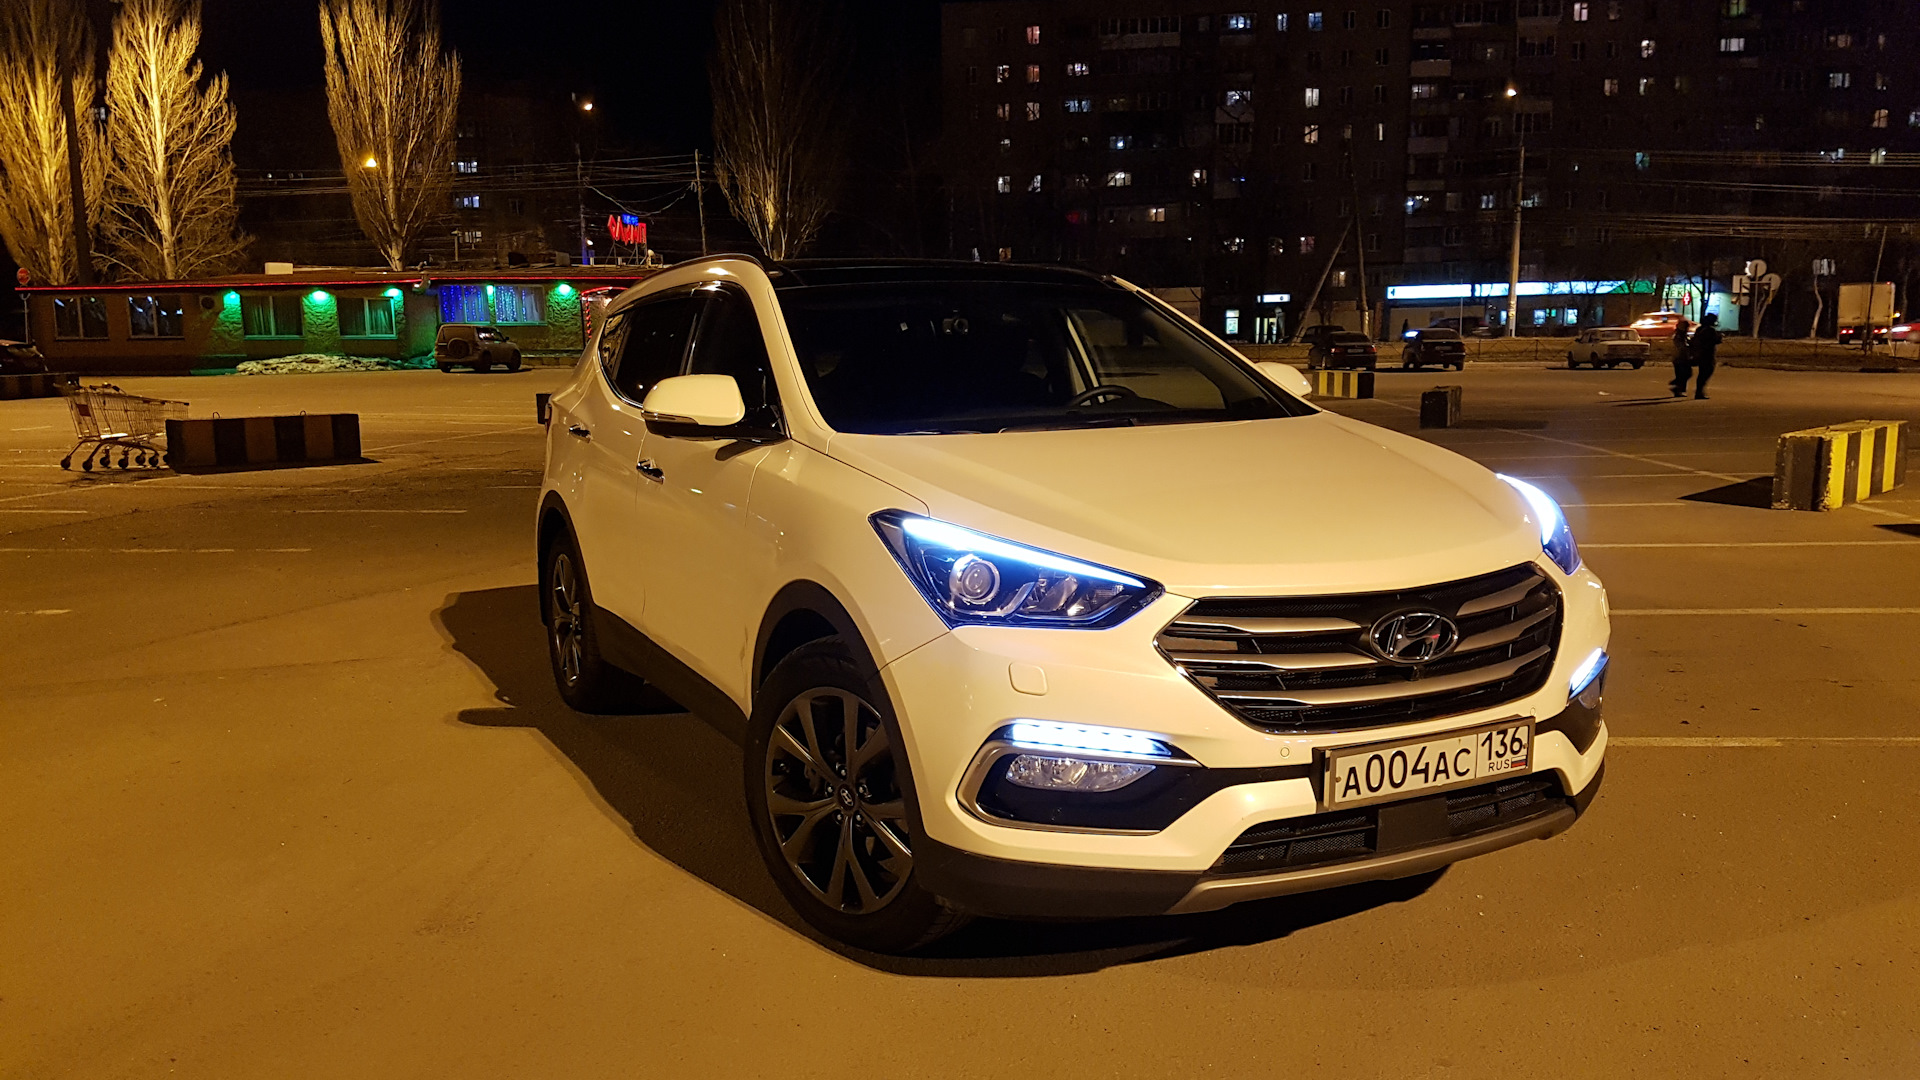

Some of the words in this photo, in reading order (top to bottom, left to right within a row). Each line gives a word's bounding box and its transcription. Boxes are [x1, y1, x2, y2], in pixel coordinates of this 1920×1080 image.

[1342, 746, 1471, 798] А004АС
[1480, 726, 1524, 761] 136
[1488, 758, 1510, 773] RUS
